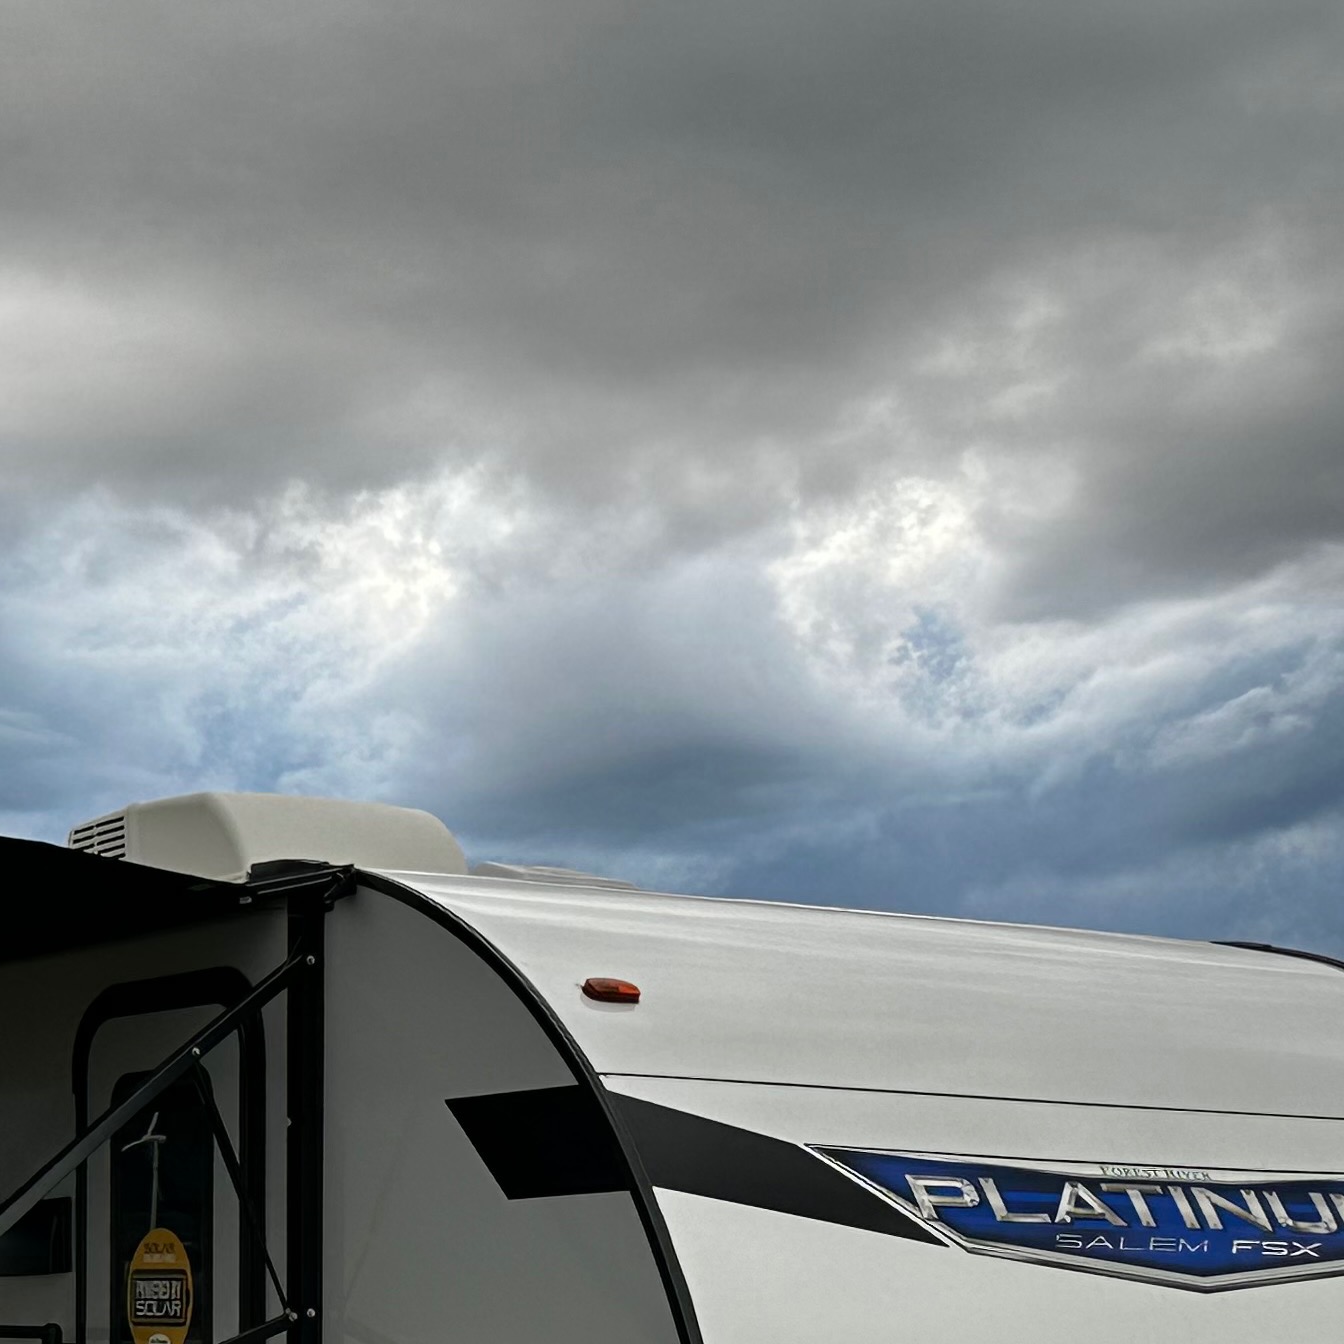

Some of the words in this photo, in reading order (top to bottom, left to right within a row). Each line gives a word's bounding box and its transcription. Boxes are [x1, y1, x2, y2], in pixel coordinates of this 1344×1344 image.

[1054, 1233, 1210, 1254] SALEM
[1230, 1237, 1322, 1259] FSX
[135, 1300, 182, 1317] SOLAR
